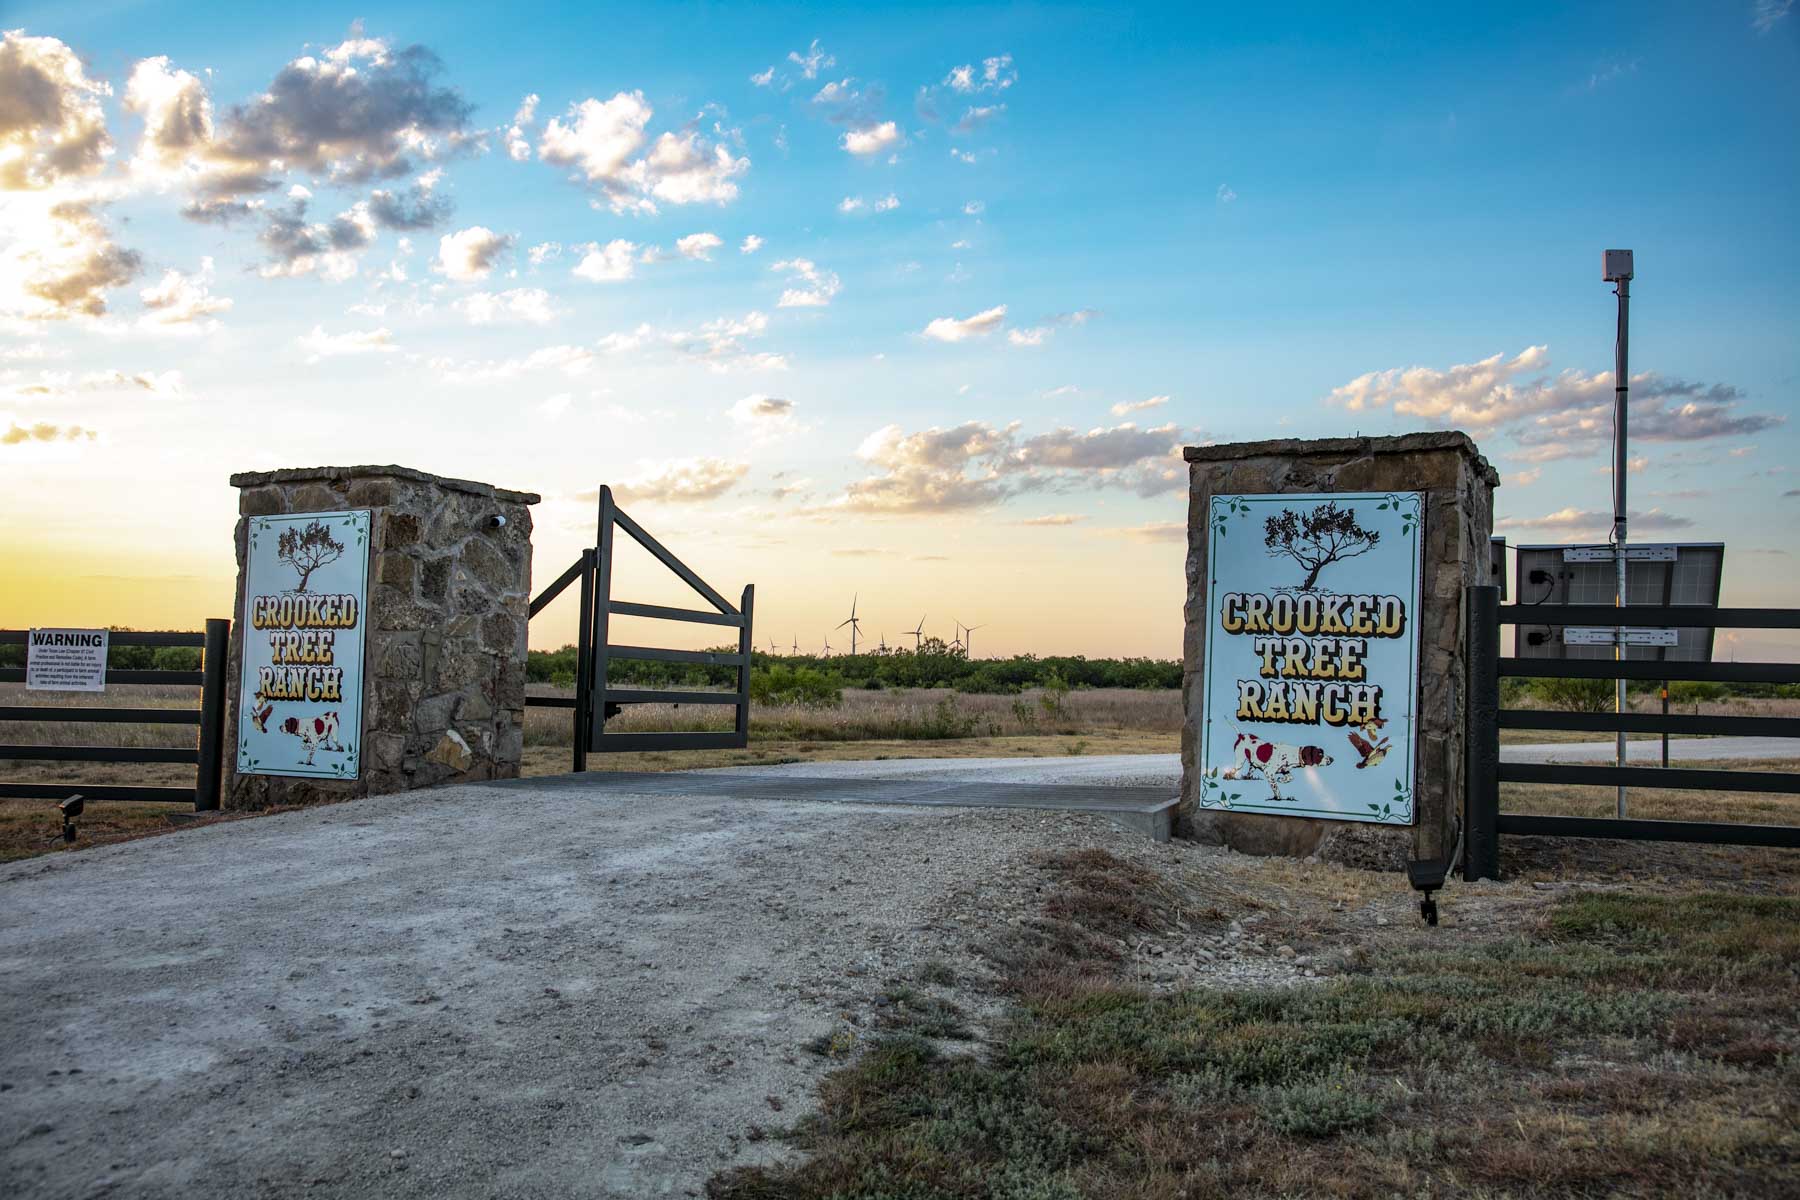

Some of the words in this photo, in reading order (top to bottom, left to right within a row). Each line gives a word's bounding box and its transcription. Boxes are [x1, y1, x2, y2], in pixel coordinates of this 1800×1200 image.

[252, 594, 359, 631] CROOKED
[1220, 592, 1407, 639] CROOKED
[33, 633, 102, 647] WARNING
[270, 631, 335, 666] TREE
[1255, 637, 1368, 683] TREE
[259, 666, 343, 703] RANCH
[1236, 679, 1383, 726] RANCH
